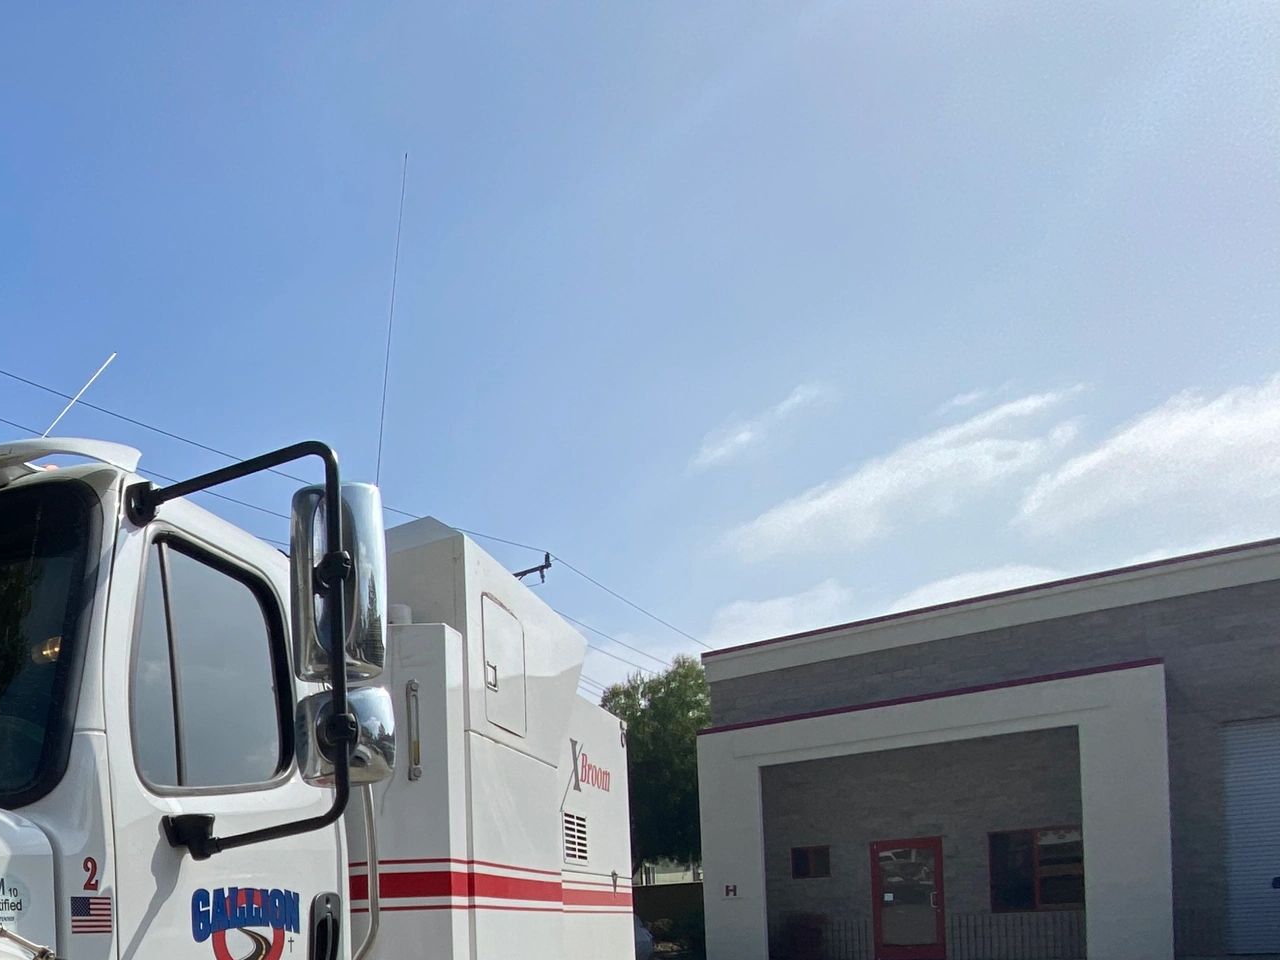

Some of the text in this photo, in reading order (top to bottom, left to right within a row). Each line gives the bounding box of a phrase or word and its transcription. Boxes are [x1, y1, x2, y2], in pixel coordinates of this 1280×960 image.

[83, 856, 99, 891] 2
[8, 887, 19, 898] 10
[725, 885, 737, 896] H
